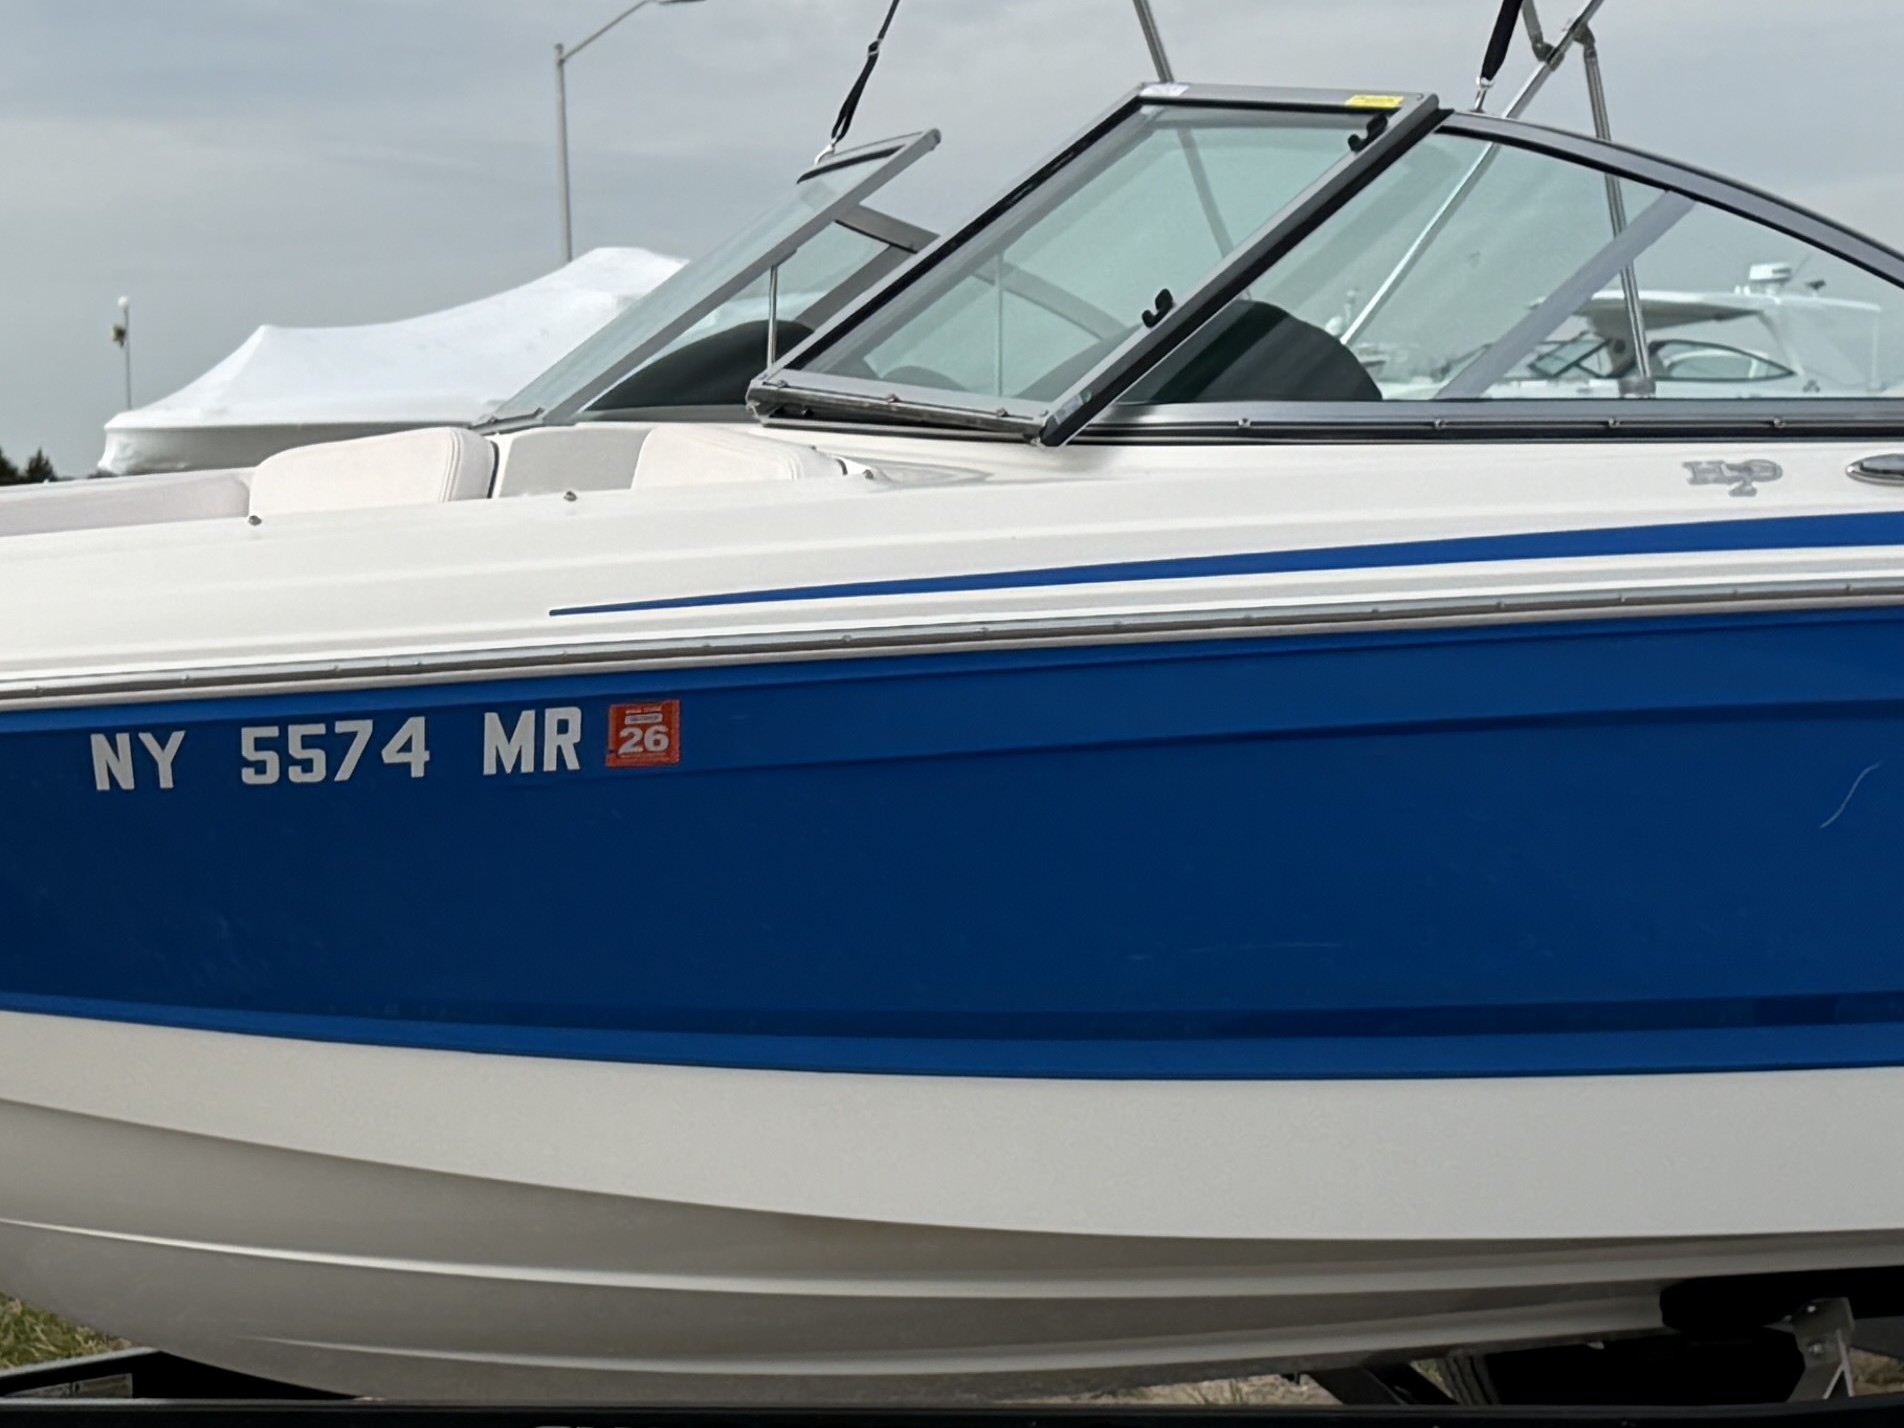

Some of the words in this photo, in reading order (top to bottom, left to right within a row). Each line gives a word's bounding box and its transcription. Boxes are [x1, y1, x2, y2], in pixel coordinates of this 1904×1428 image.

[91, 730, 186, 790] NY
[241, 717, 430, 785] 5574
[483, 706, 582, 776] MR
[618, 724, 669, 755] 26
